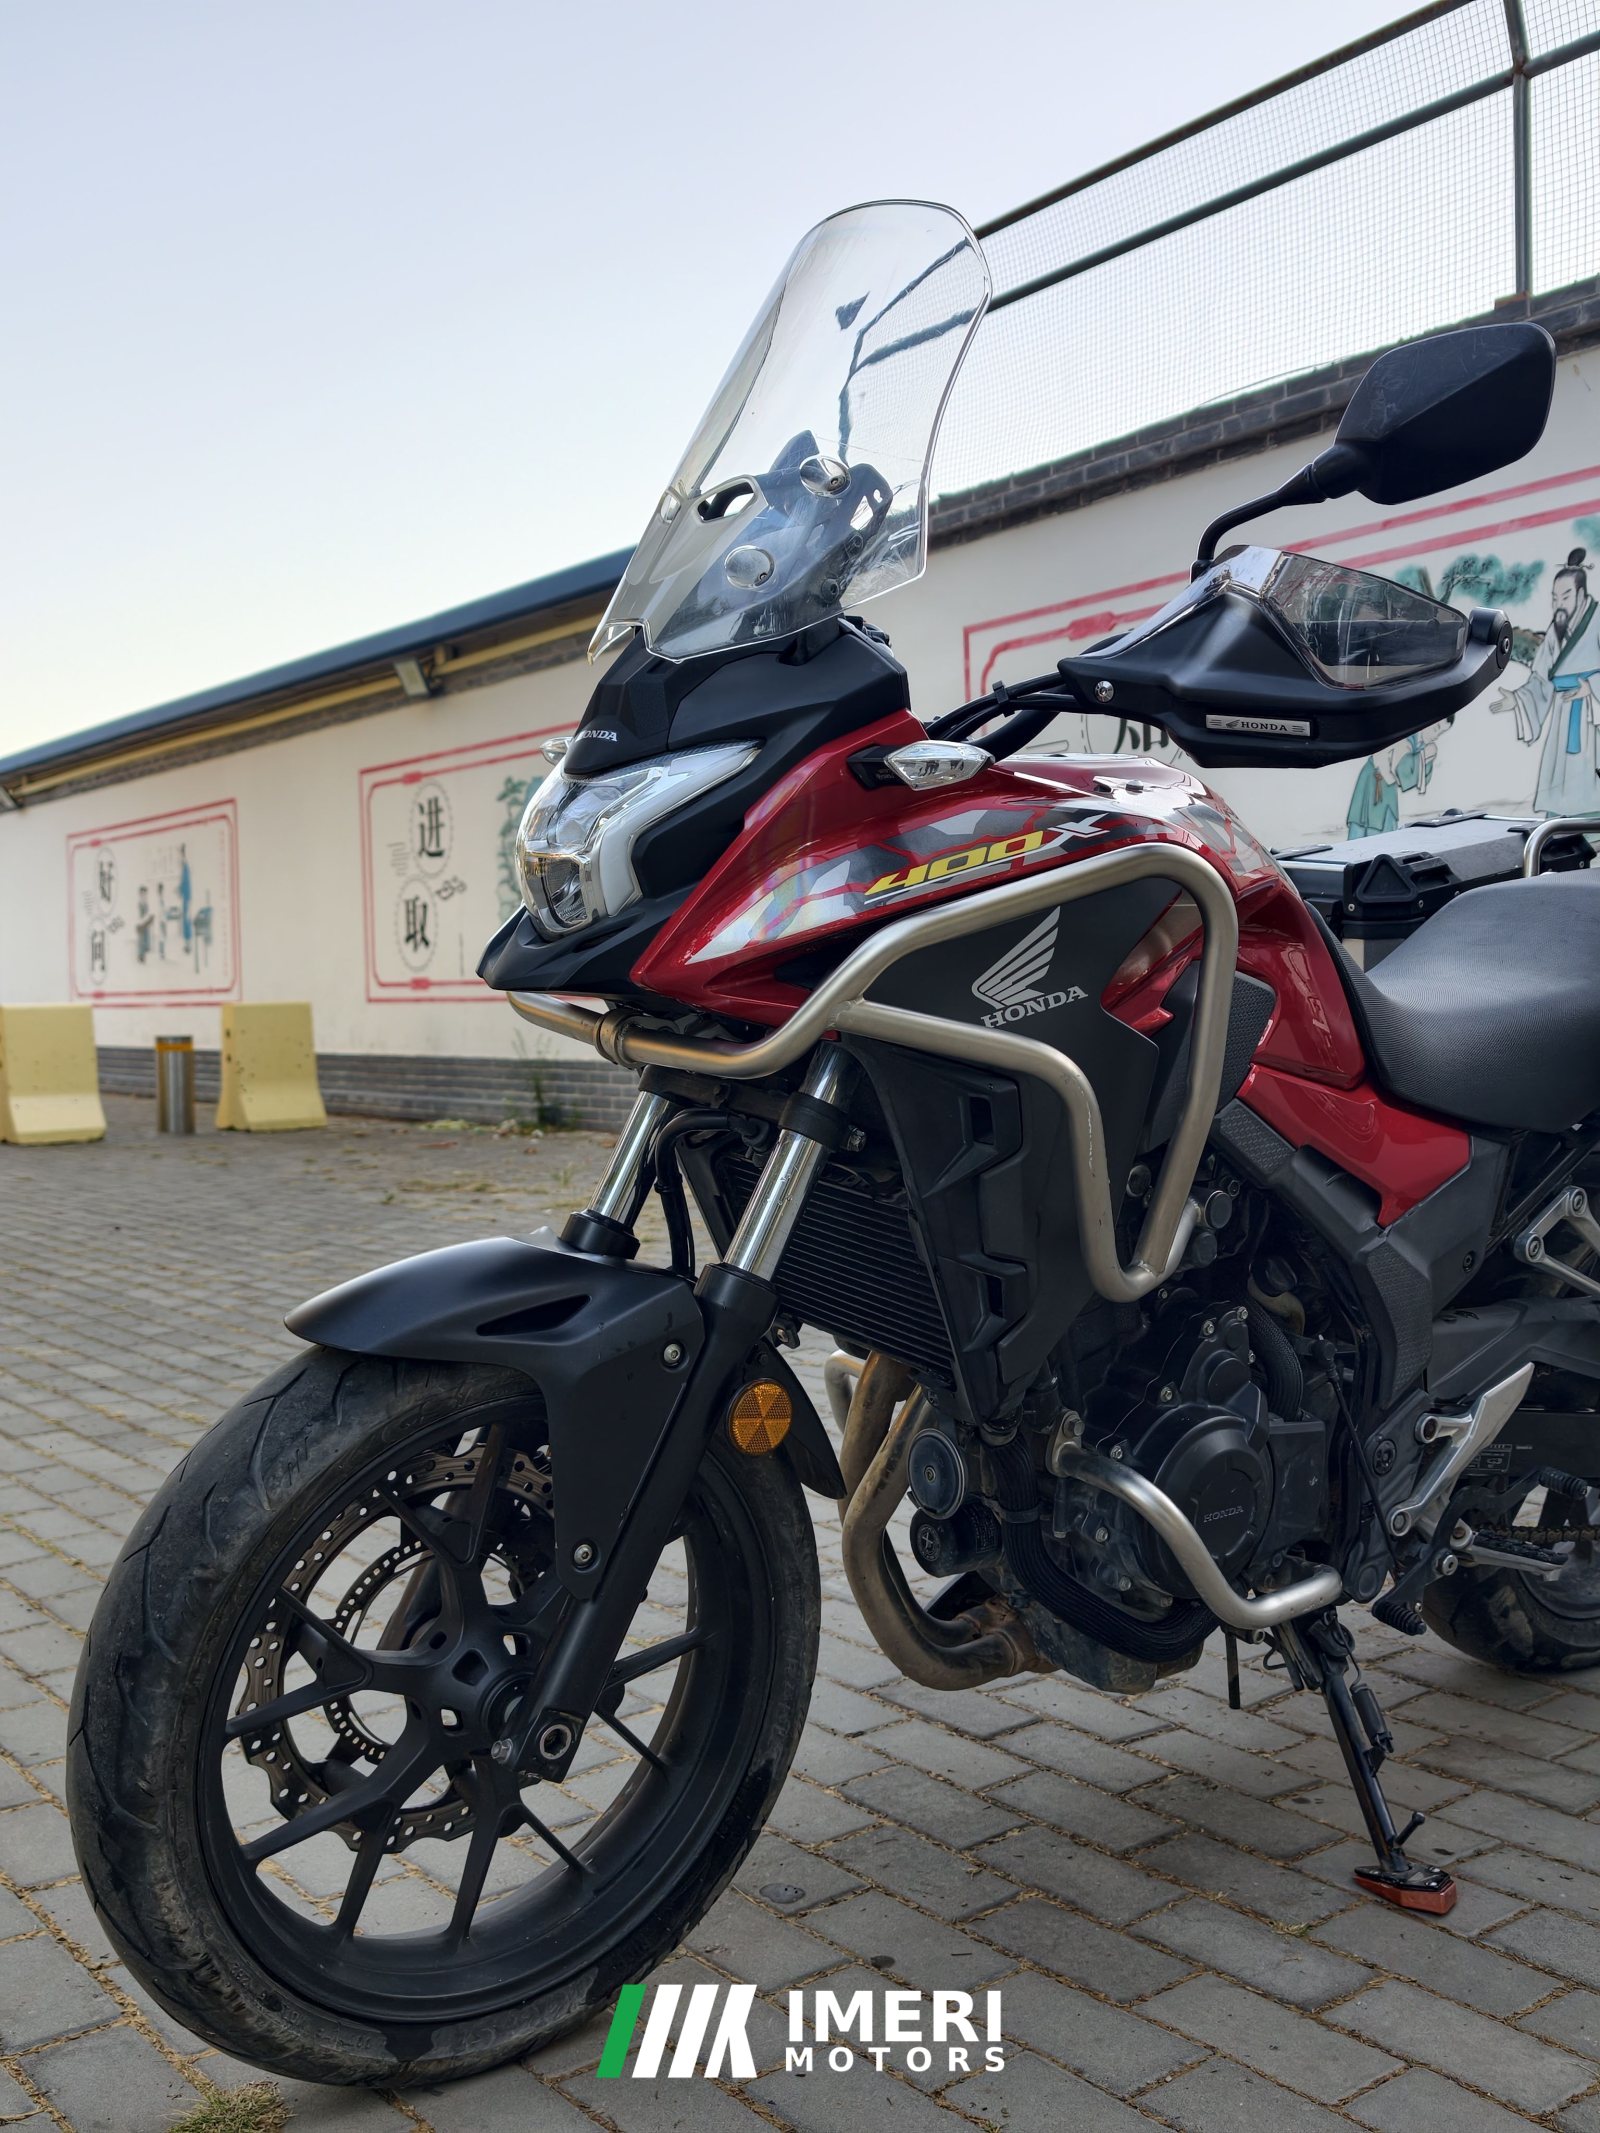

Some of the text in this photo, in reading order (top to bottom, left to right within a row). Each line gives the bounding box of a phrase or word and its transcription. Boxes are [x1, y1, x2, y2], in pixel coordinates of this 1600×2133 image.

[1241, 721, 1288, 731] HONDA
[981, 985, 1088, 1028] HONDA
[1203, 1505, 1244, 1523] HONDA
